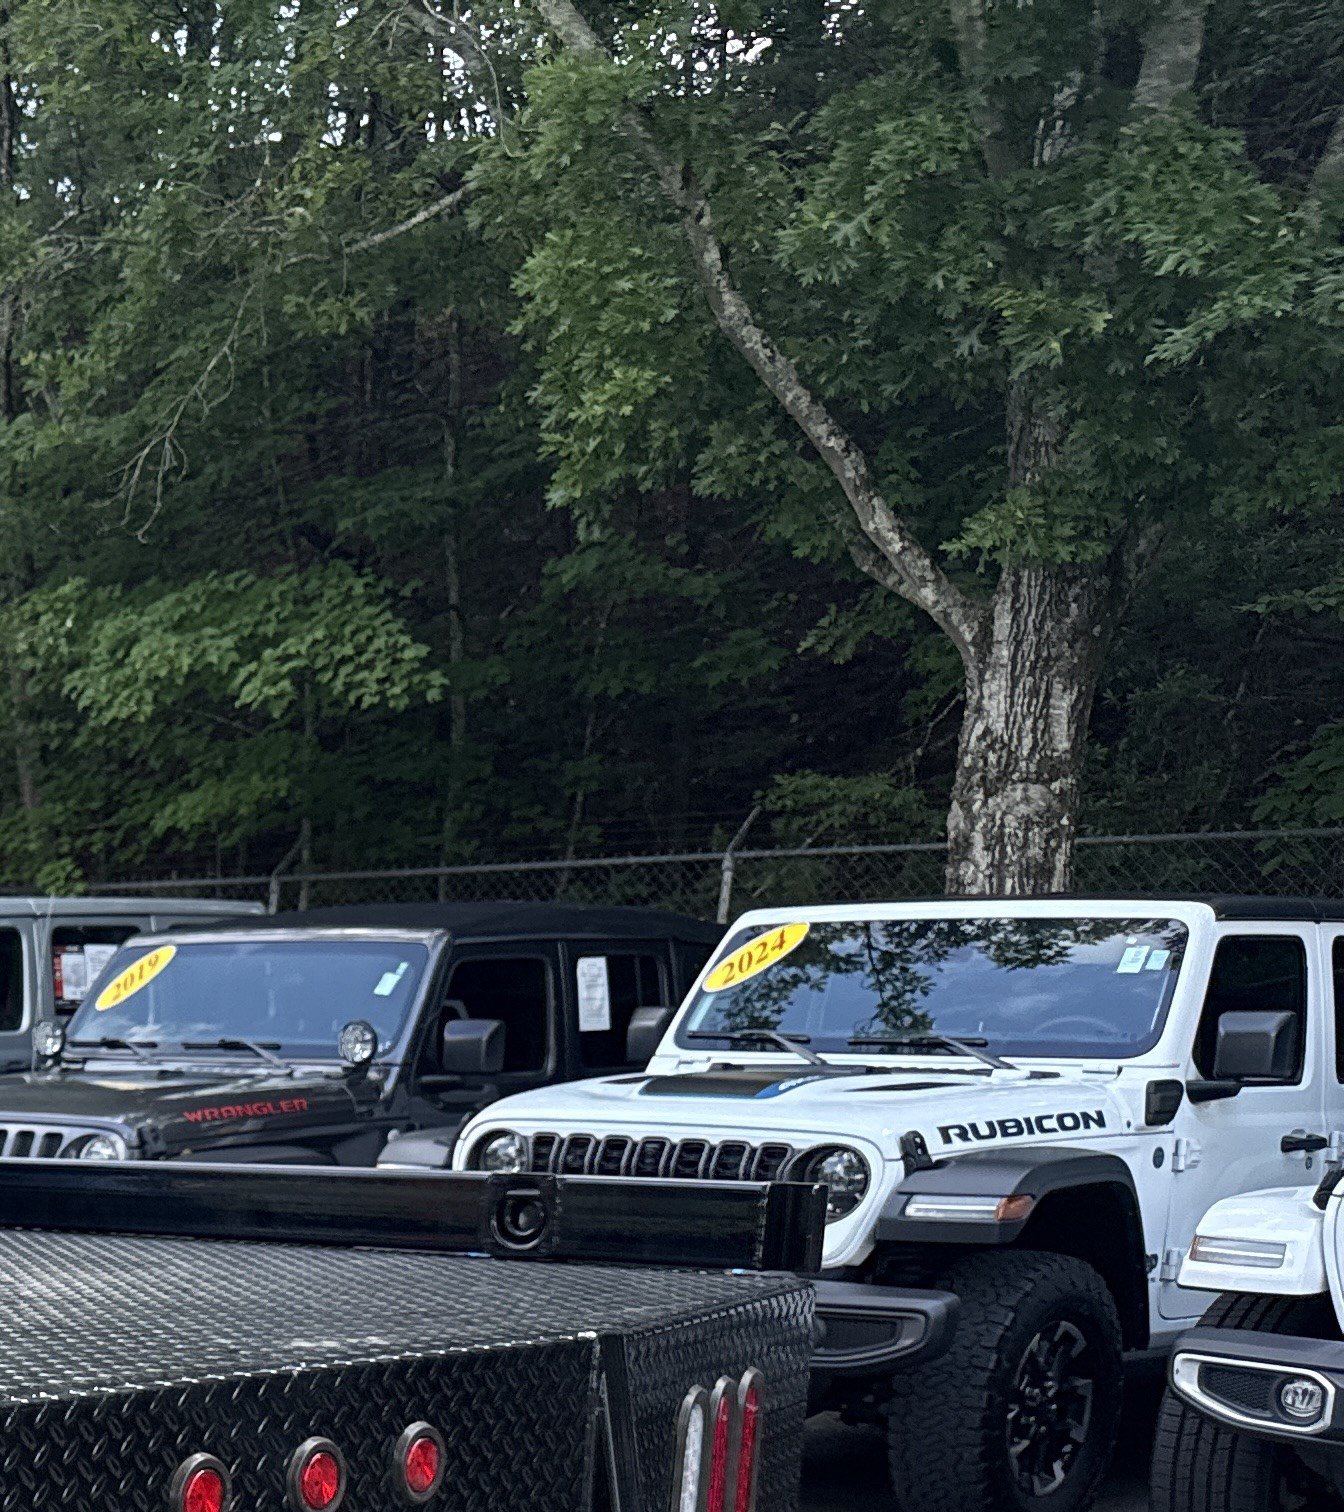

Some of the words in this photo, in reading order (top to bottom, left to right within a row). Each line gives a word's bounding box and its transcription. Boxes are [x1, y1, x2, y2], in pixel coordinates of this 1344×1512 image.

[112, 954, 159, 1000] 2019
[722, 929, 786, 986] 2024
[182, 1097, 308, 1123] WRANGLER
[937, 1110, 1107, 1146] RUBICON
